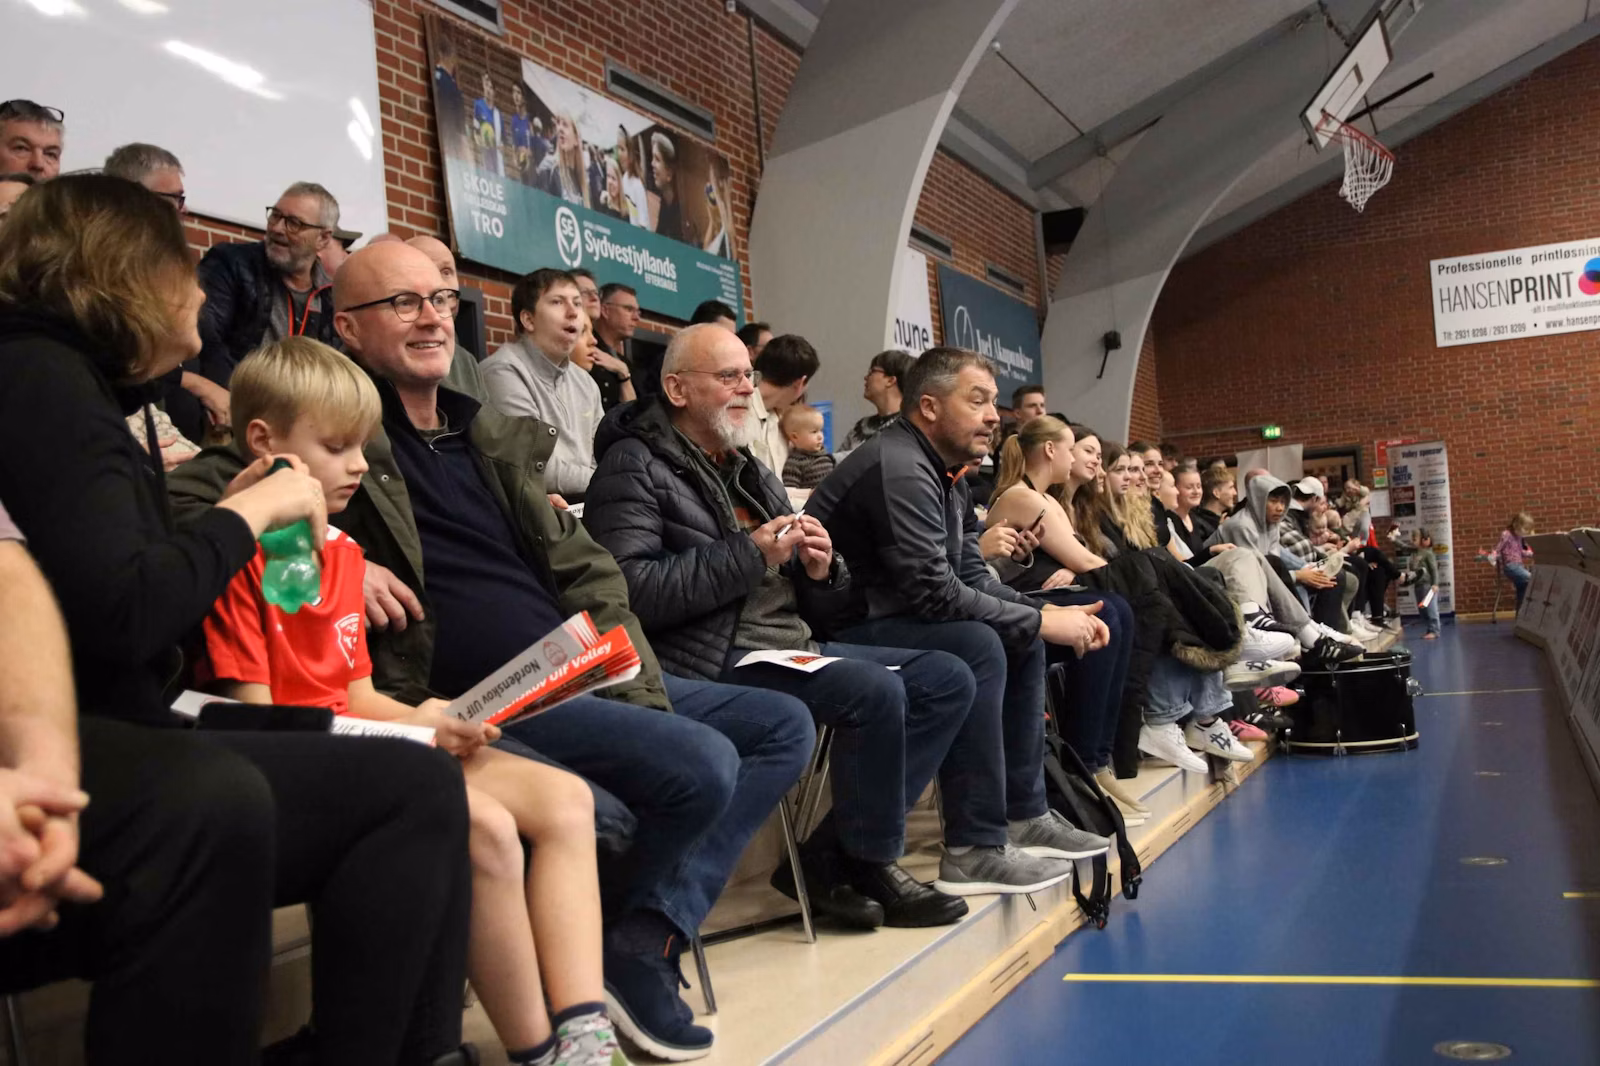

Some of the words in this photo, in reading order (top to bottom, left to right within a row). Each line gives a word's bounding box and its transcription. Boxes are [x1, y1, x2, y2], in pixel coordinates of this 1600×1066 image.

[463, 172, 504, 201] SKOLE
[471, 209, 503, 238] TRO
[560, 216, 575, 237] SE
[583, 229, 678, 280] Sydvestjyllands
[1438, 255, 1522, 275] Professionelle
[1439, 271, 1574, 314] HANSENPRINT
[1455, 329, 1470, 339] 2931
[1493, 324, 1508, 335] 2931
[549, 663, 570, 682] UIF
[571, 641, 612, 669] Volley
[481, 658, 541, 705] Nordenskov
[466, 699, 484, 719] UIF
